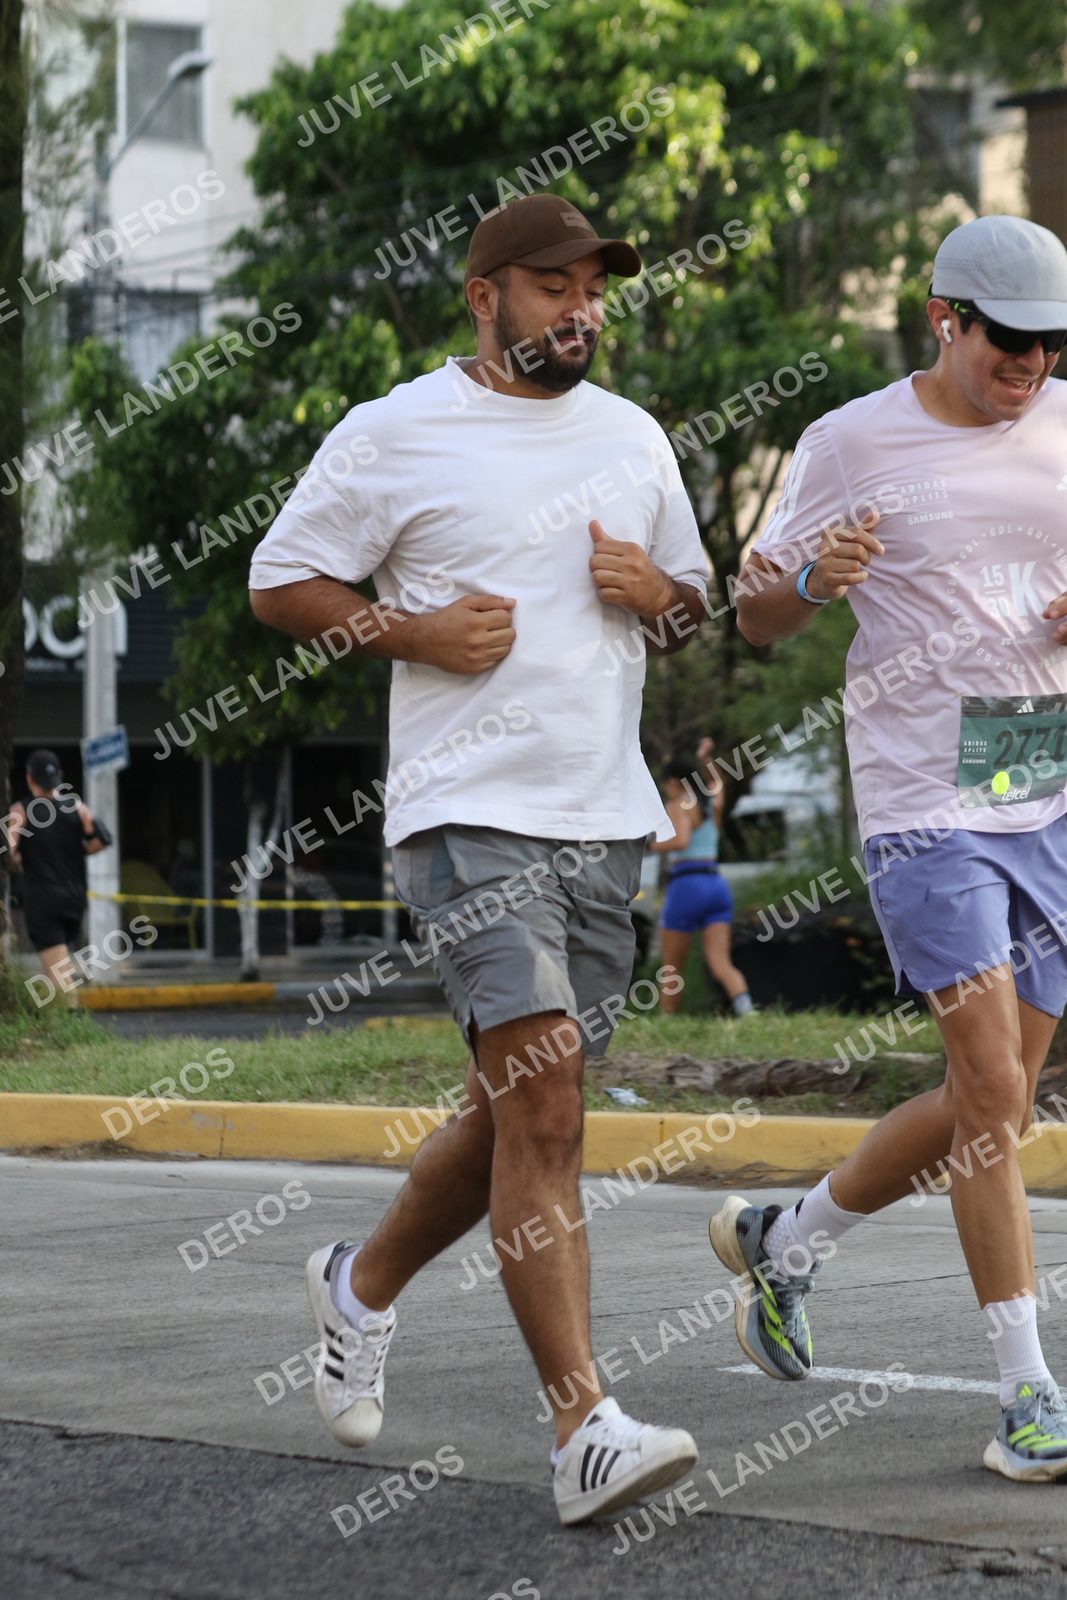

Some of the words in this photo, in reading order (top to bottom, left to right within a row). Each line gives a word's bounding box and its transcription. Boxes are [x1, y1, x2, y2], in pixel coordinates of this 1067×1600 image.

[900, 479, 948, 495] ADIDAS
[904, 490, 949, 506] SPLITS
[907, 510, 954, 526] SAMSUNG
[989, 525, 1013, 537] GDL
[1026, 526, 1051, 544] GDL
[980, 564, 1005, 588] 15
[1008, 561, 1045, 617] K
[1001, 786, 1032, 802] telcel
